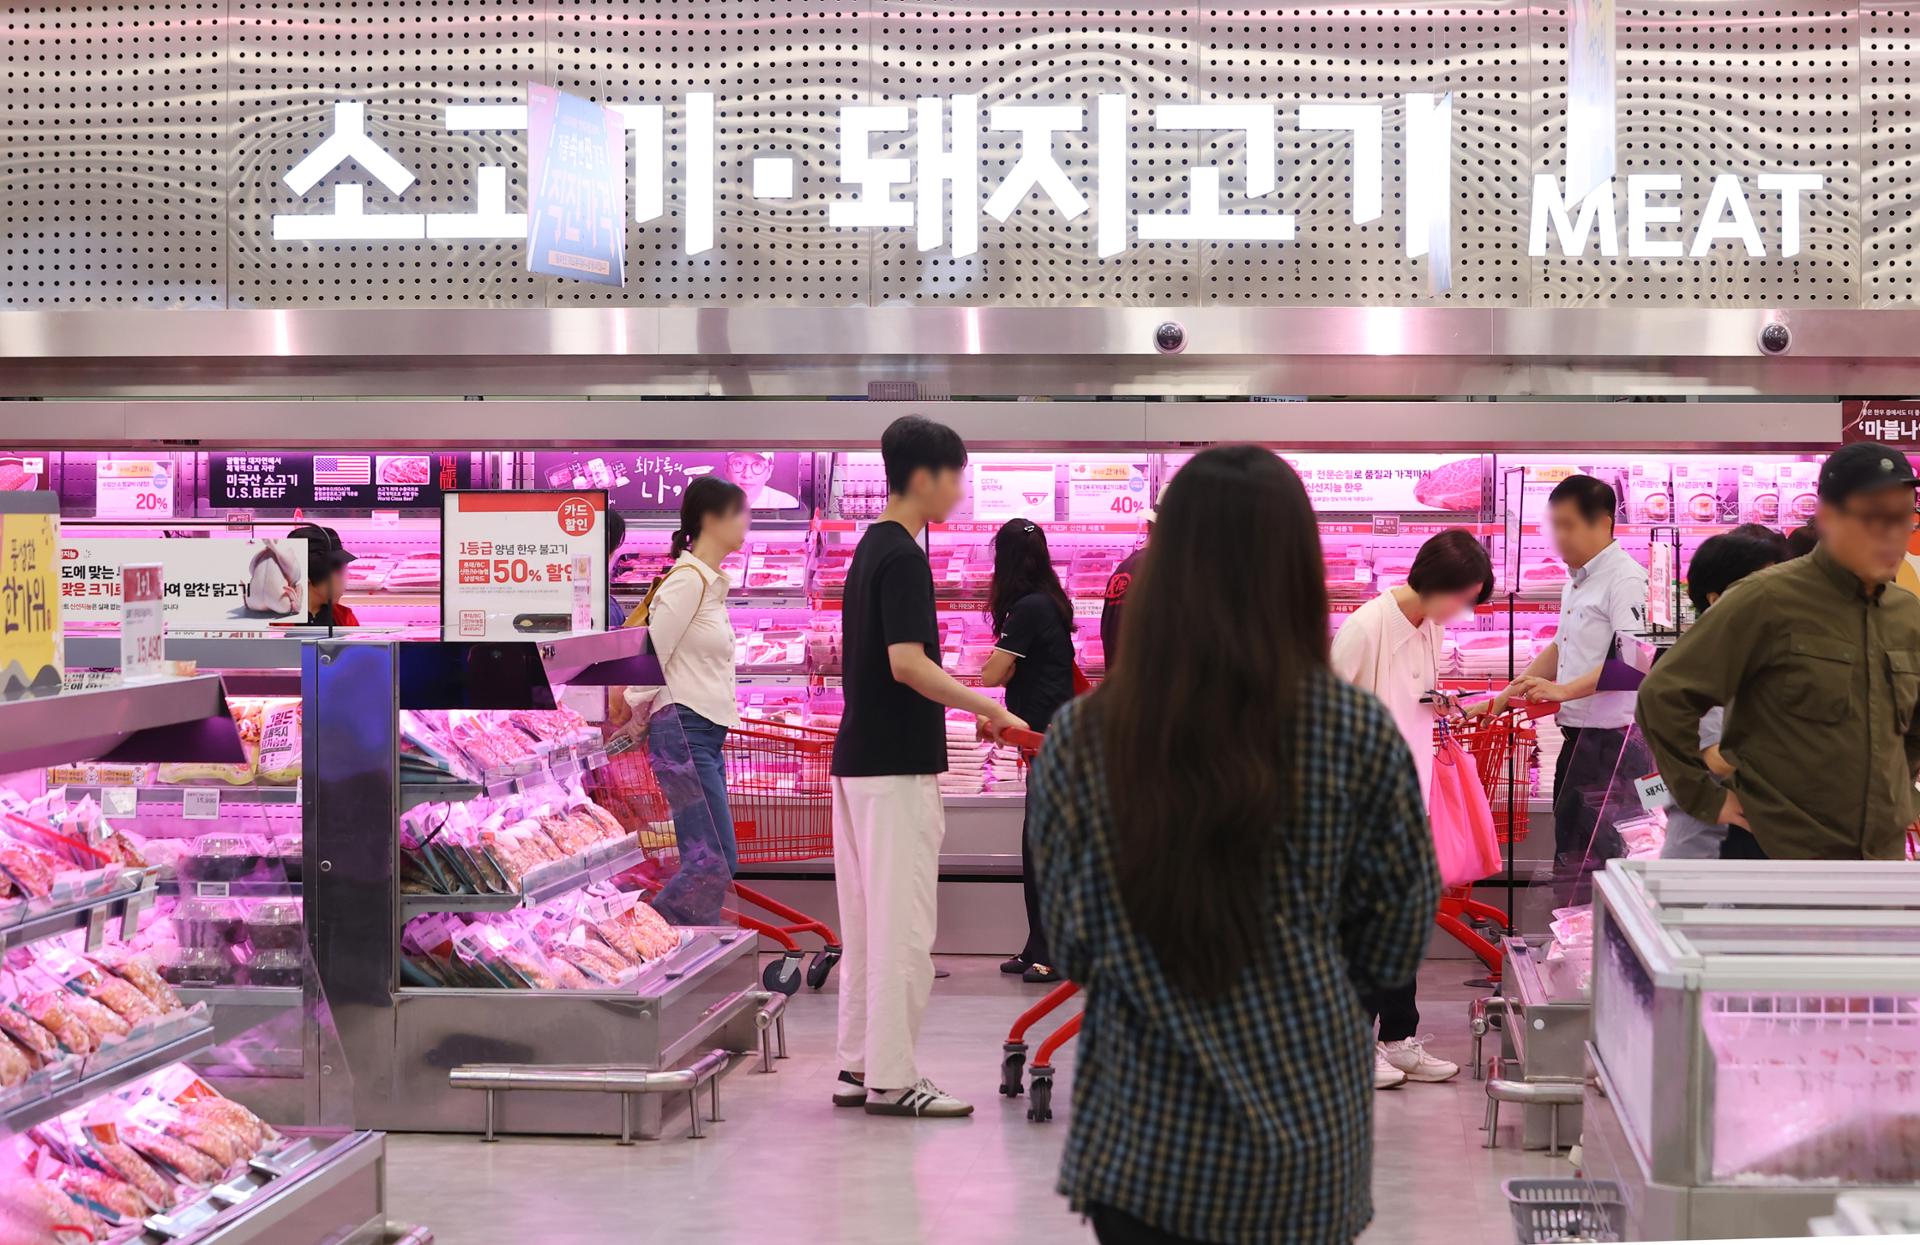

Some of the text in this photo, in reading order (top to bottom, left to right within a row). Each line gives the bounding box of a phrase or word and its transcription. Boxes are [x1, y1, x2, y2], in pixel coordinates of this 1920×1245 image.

[1528, 174, 1823, 259] MEAT
[1858, 419, 1920, 441] ‘마블나
[634, 455, 683, 476] 최강록의
[226, 474, 298, 487] 미국산 소고기
[1365, 469, 1392, 480] 품질과
[1395, 469, 1432, 480] 가격까지
[226, 487, 286, 499] U.S.BEEF
[1344, 482, 1363, 493] 한우
[136, 493, 168, 510] 20%
[1110, 496, 1144, 514] 40%
[564, 504, 588, 517] 카드
[564, 518, 588, 531] 할인
[459, 541, 568, 555] 1등급 양념 한우 불고기
[89, 565, 114, 579] 맞는
[494, 559, 542, 584] 50%
[183, 582, 210, 597] 알찬
[212, 582, 251, 598] 닭고기
[1645, 783, 1667, 797] 돼지
